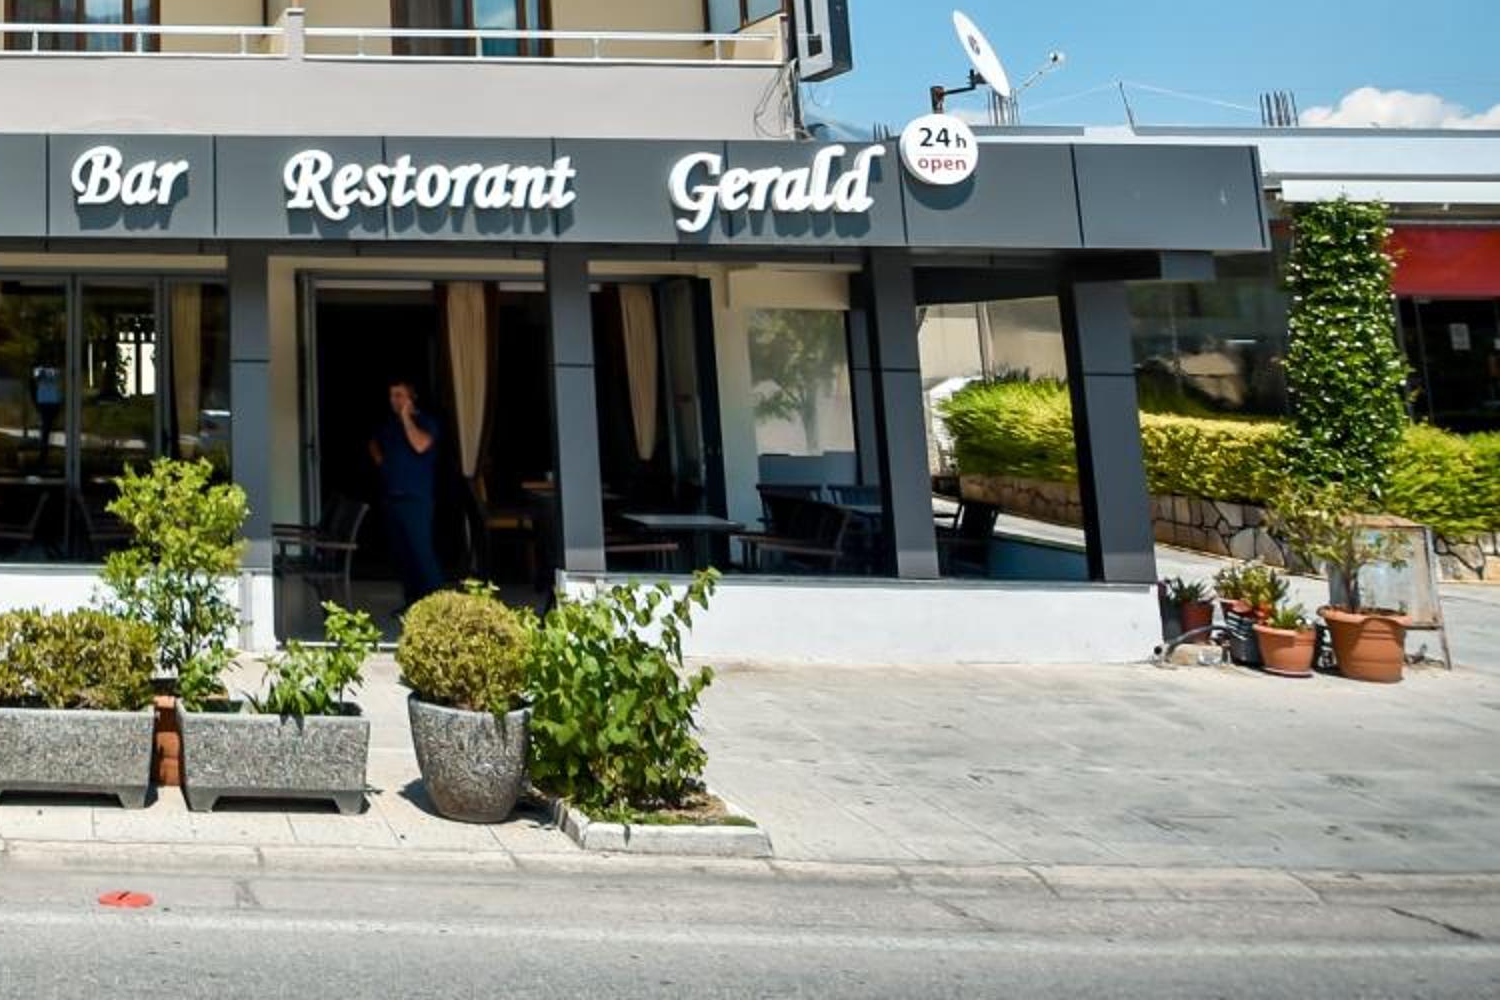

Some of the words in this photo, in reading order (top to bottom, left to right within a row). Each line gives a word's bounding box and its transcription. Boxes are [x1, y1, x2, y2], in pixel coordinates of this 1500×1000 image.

[71, 146, 188, 204] Bar
[283, 149, 576, 220] Restorant
[668, 144, 885, 232] Gerald
[918, 158, 967, 173] open
